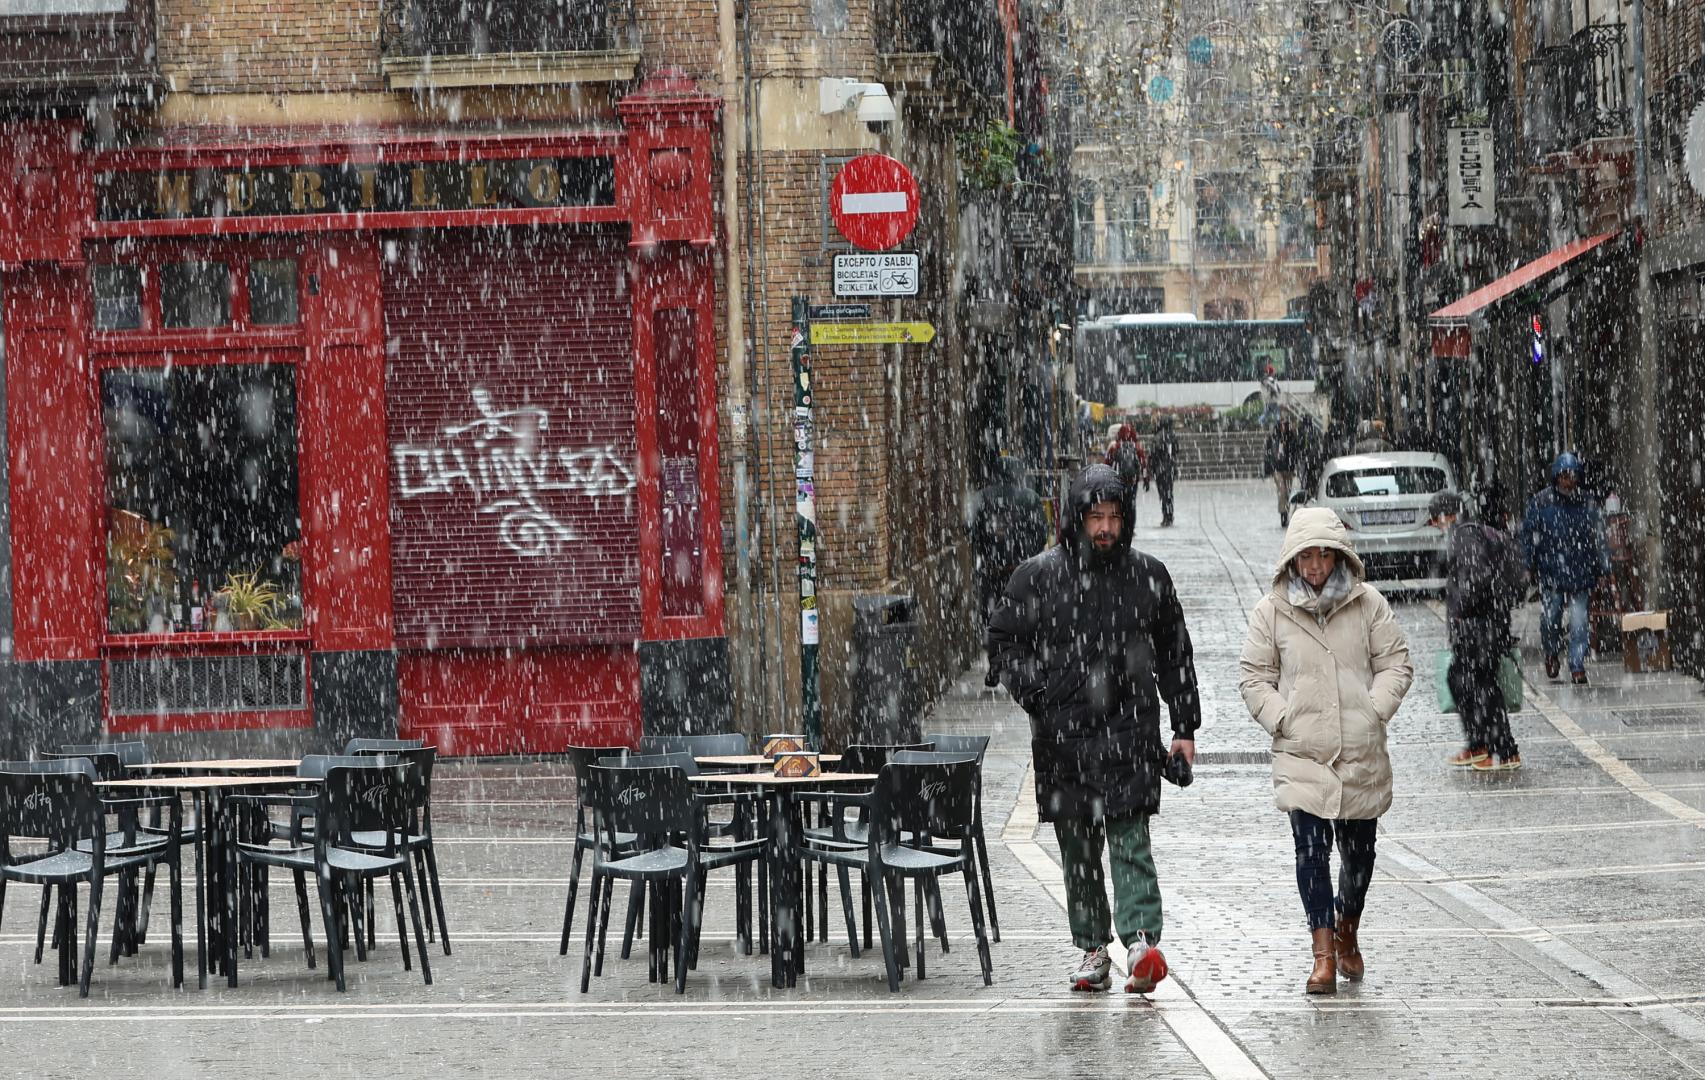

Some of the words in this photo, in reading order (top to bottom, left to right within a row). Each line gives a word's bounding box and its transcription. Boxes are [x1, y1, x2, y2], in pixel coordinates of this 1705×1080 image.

[153, 165, 561, 214] MURILLO
[838, 257, 876, 268] EXCEPTO
[878, 257, 882, 267] /
[837, 270, 879, 279] BICICLETAS
[838, 283, 878, 292] BIZIKLETAK
